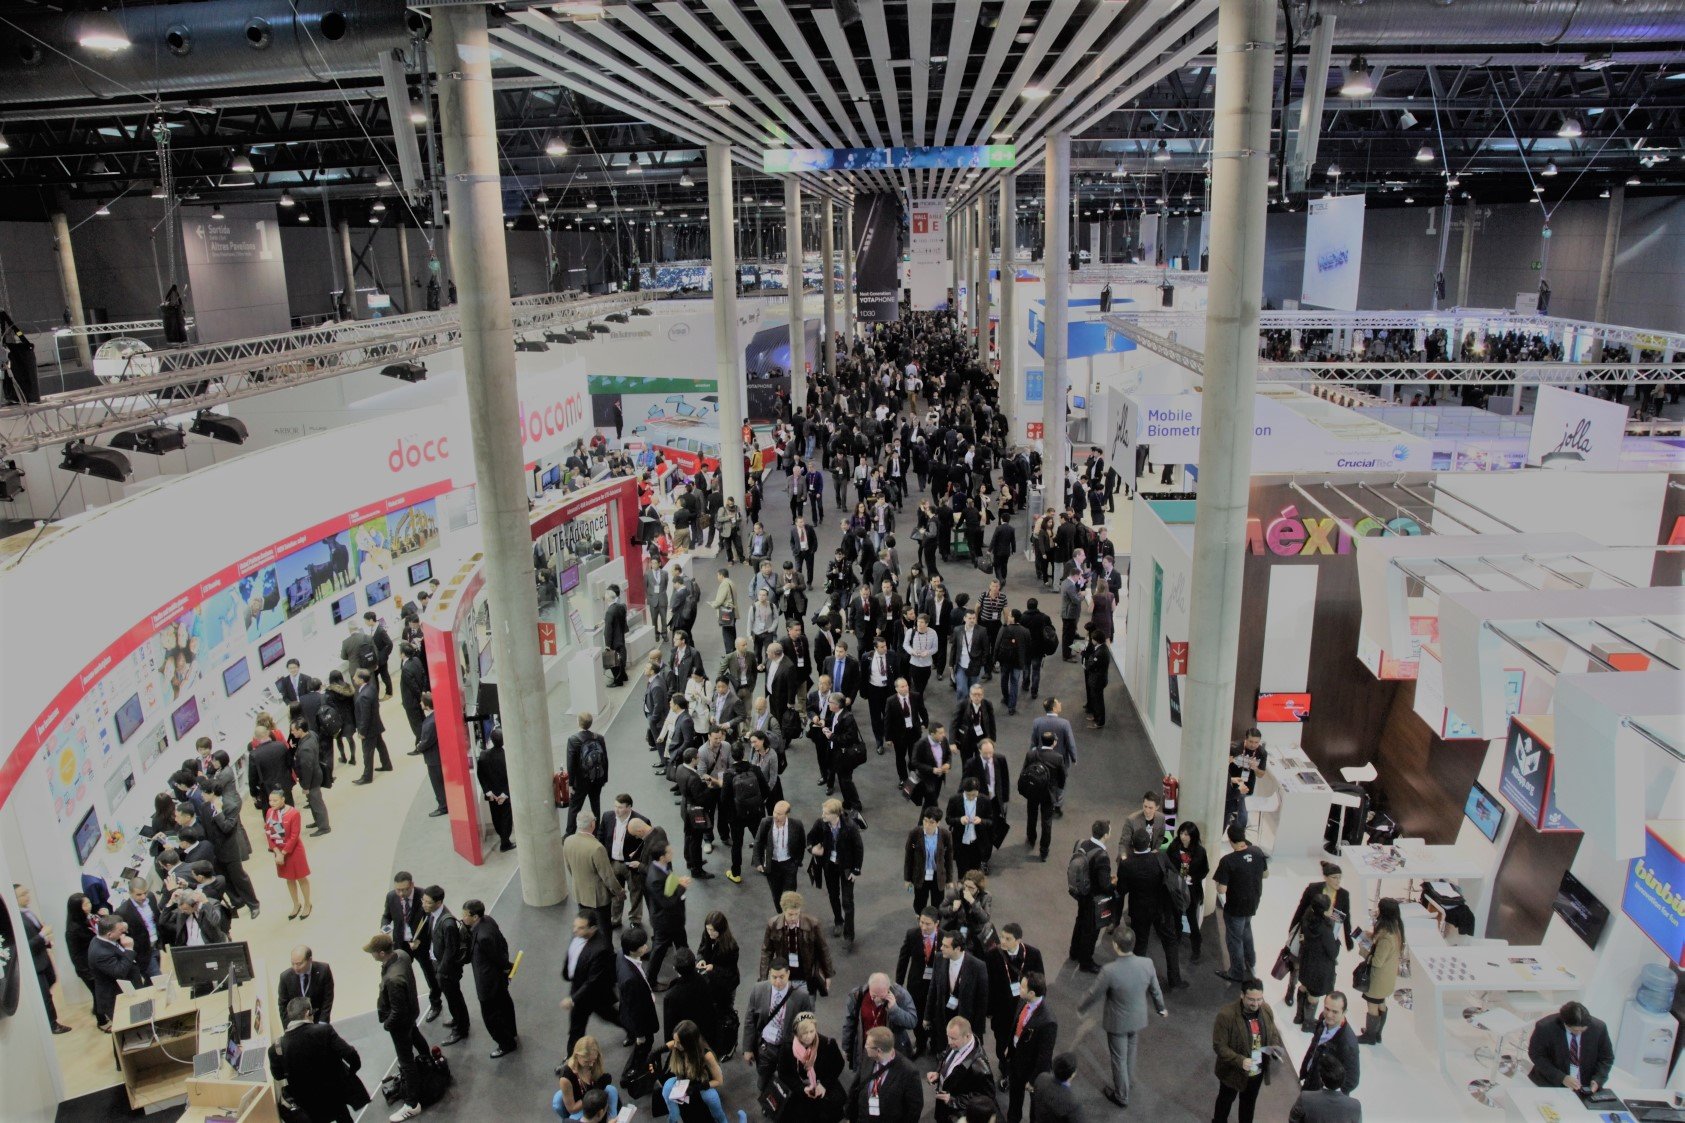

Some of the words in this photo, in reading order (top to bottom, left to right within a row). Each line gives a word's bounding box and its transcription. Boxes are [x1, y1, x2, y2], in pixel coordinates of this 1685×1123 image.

[883, 148, 895, 167] 1
[917, 221, 923, 232] 1
[932, 221, 939, 231] E
[1425, 207, 1437, 235] 1
[256, 220, 273, 260] 1
[1148, 410, 1192, 421] Mobile
[1148, 425, 1202, 437] Biometr
[1554, 418, 1592, 453] jolla
